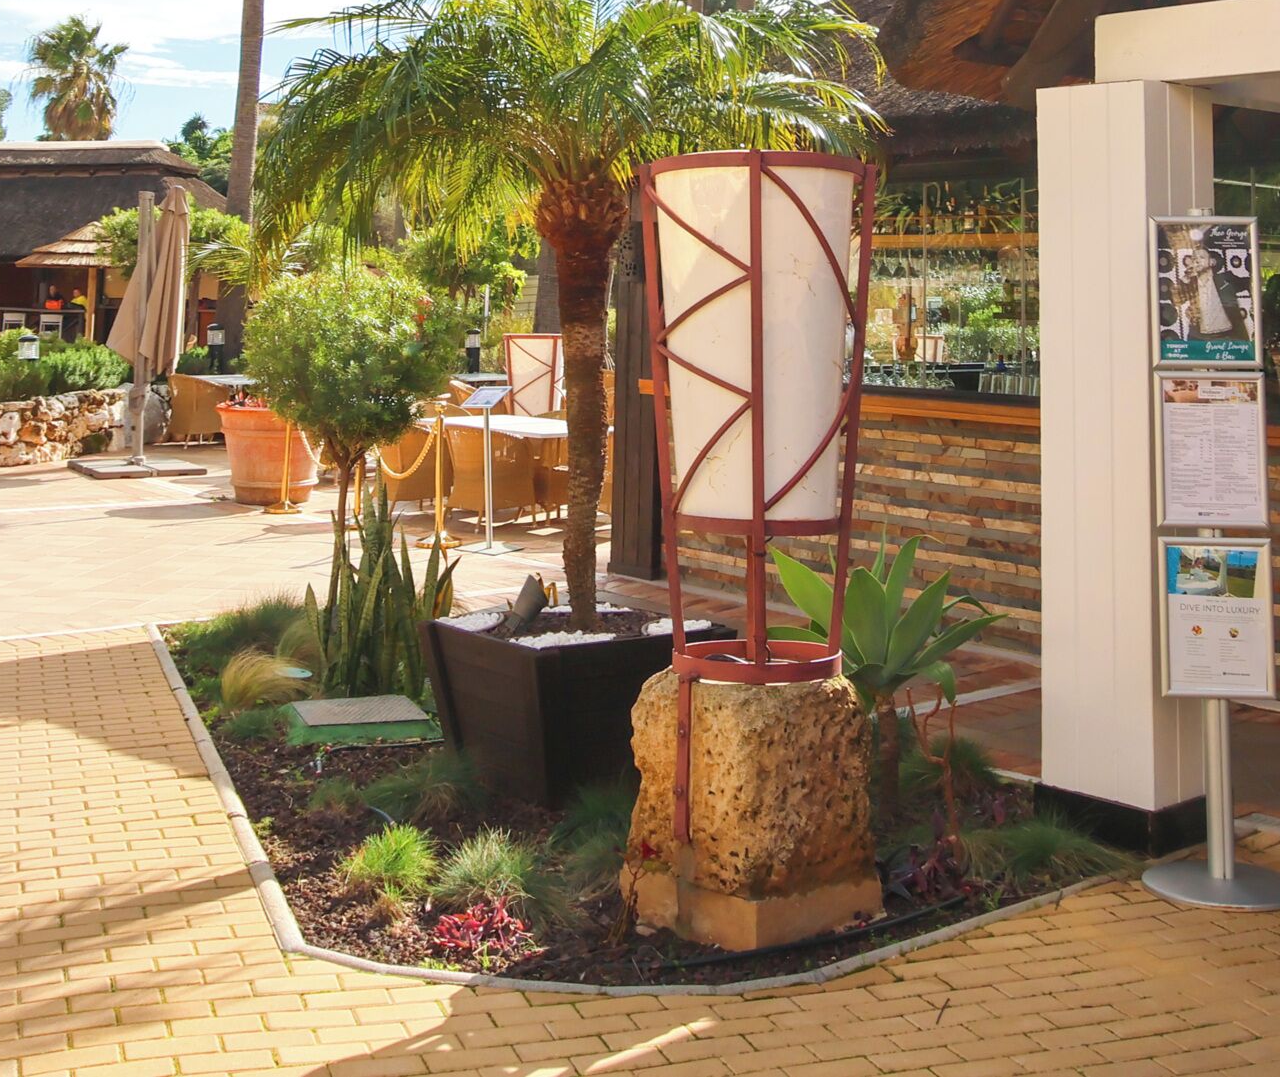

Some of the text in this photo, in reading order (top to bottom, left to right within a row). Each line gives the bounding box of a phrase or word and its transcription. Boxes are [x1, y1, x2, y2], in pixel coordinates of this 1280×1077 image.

[1226, 228, 1248, 240] George
[1206, 341, 1248, 353] Grand Lounge
[1179, 603, 1261, 615] DIVE INTO LUXURY
